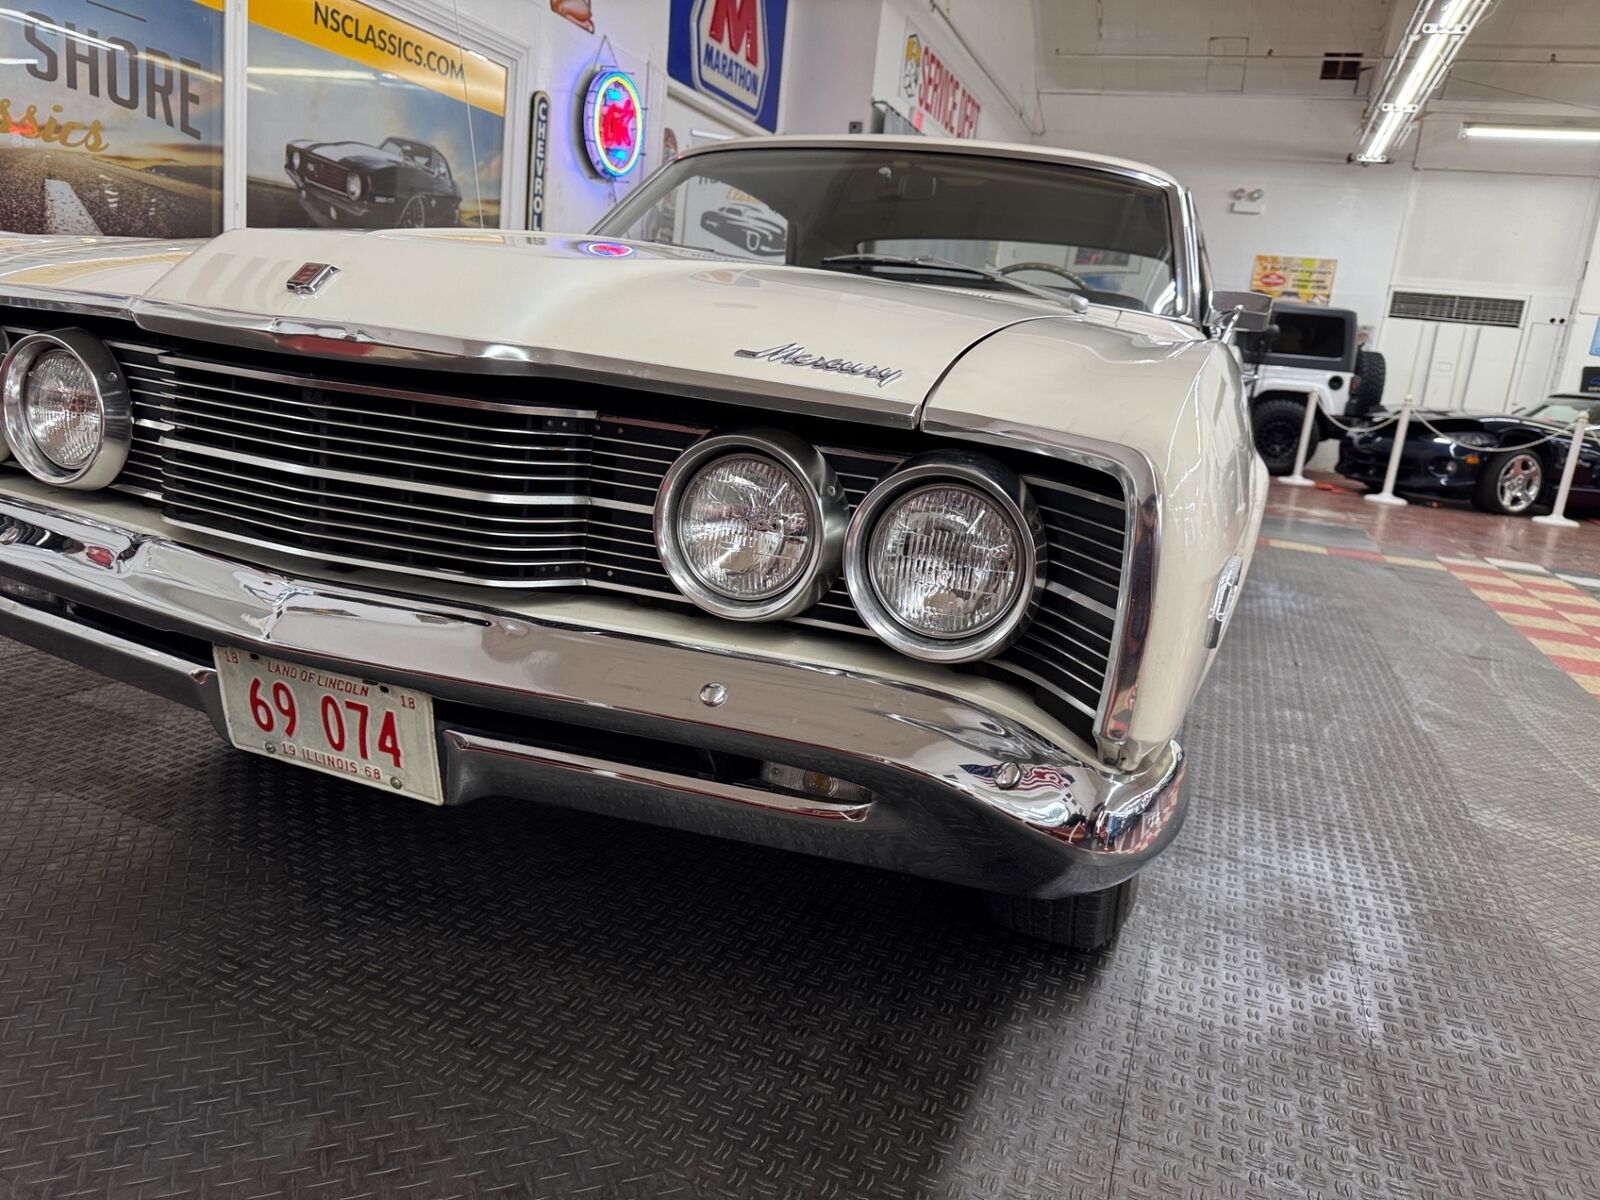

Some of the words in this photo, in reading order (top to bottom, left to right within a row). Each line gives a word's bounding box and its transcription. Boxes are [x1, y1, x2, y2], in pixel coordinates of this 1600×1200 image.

[314, 1, 465, 81] NSCLASSICS.COM
[24, 11, 201, 140] SHORE
[703, 42, 759, 97] MARATHON
[918, 46, 960, 134] SERVICE
[533, 101, 547, 231] CHEVROL
[734, 343, 902, 388] Mercury
[224, 651, 239, 664] 18
[267, 661, 297, 679] LAND
[301, 670, 316, 683] OF
[317, 672, 369, 698] LINCOLN
[249, 677, 296, 737] 69
[321, 693, 402, 769] 074
[401, 695, 415, 709] 18
[281, 743, 296, 756] 19
[302, 748, 358, 774] ILLINOIS
[364, 766, 381, 780] 68
